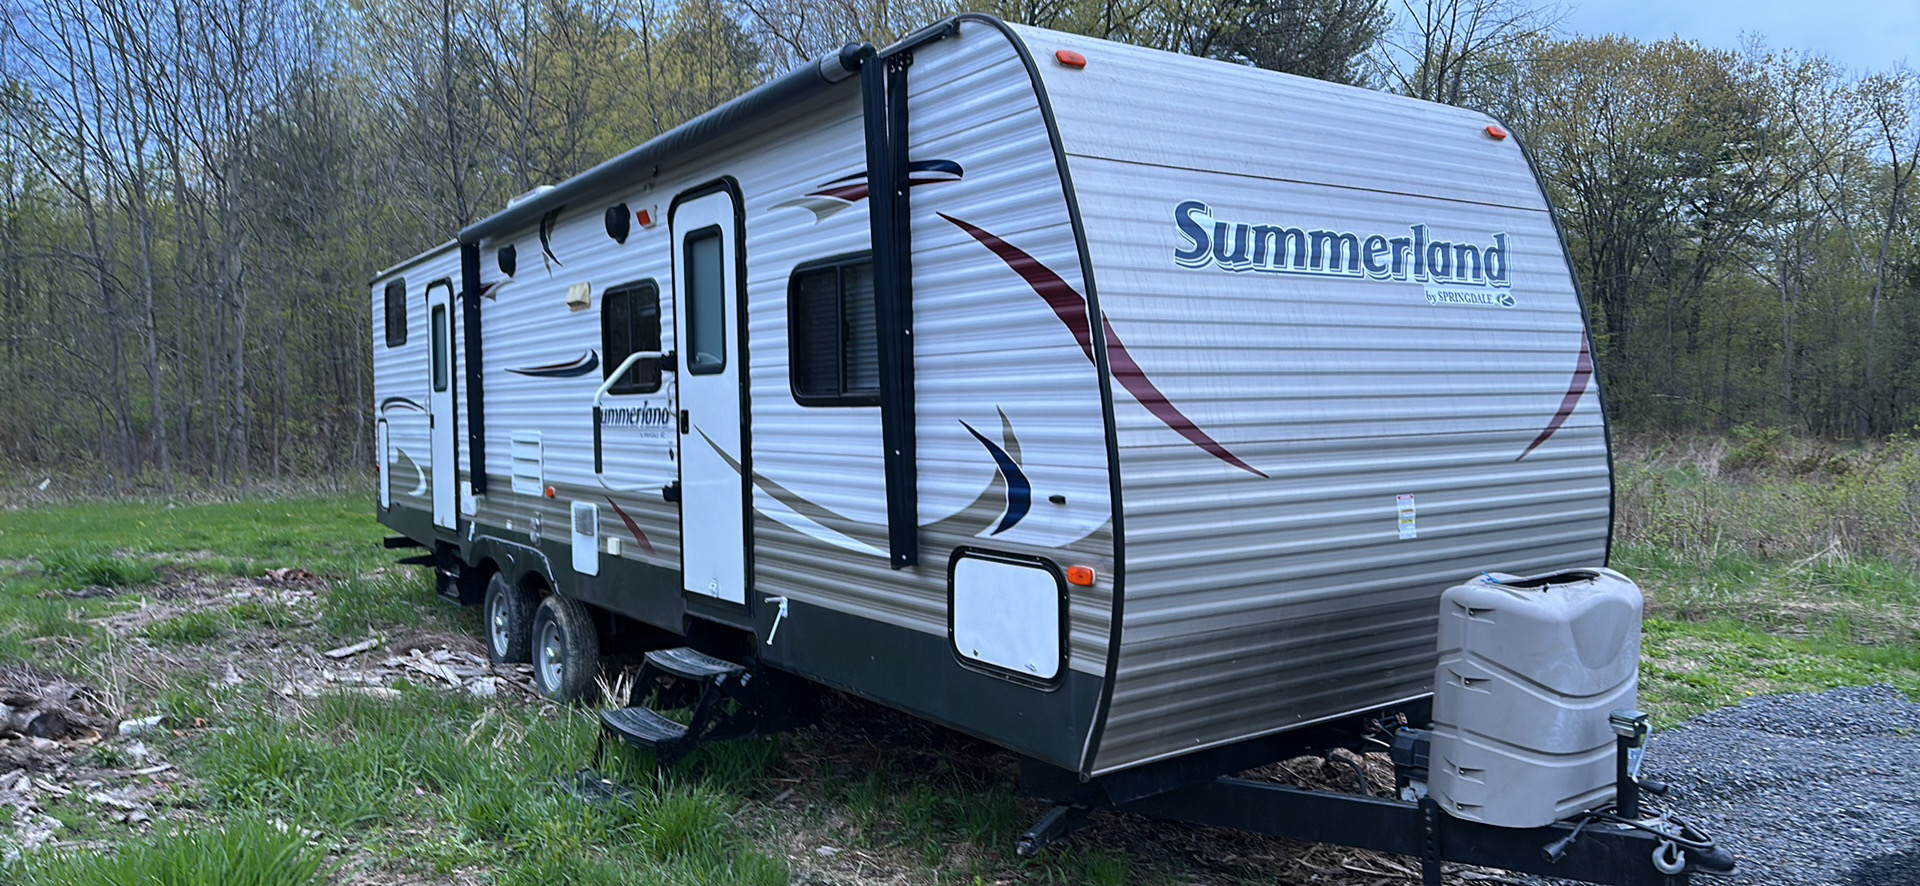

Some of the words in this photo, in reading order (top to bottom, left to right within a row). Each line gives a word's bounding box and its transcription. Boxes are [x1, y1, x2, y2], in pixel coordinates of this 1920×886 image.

[1174, 200, 1512, 288] Summerland
[1425, 290, 1437, 305] by
[1437, 290, 1494, 305] SPRINGDALE
[599, 400, 672, 425] ummerland
